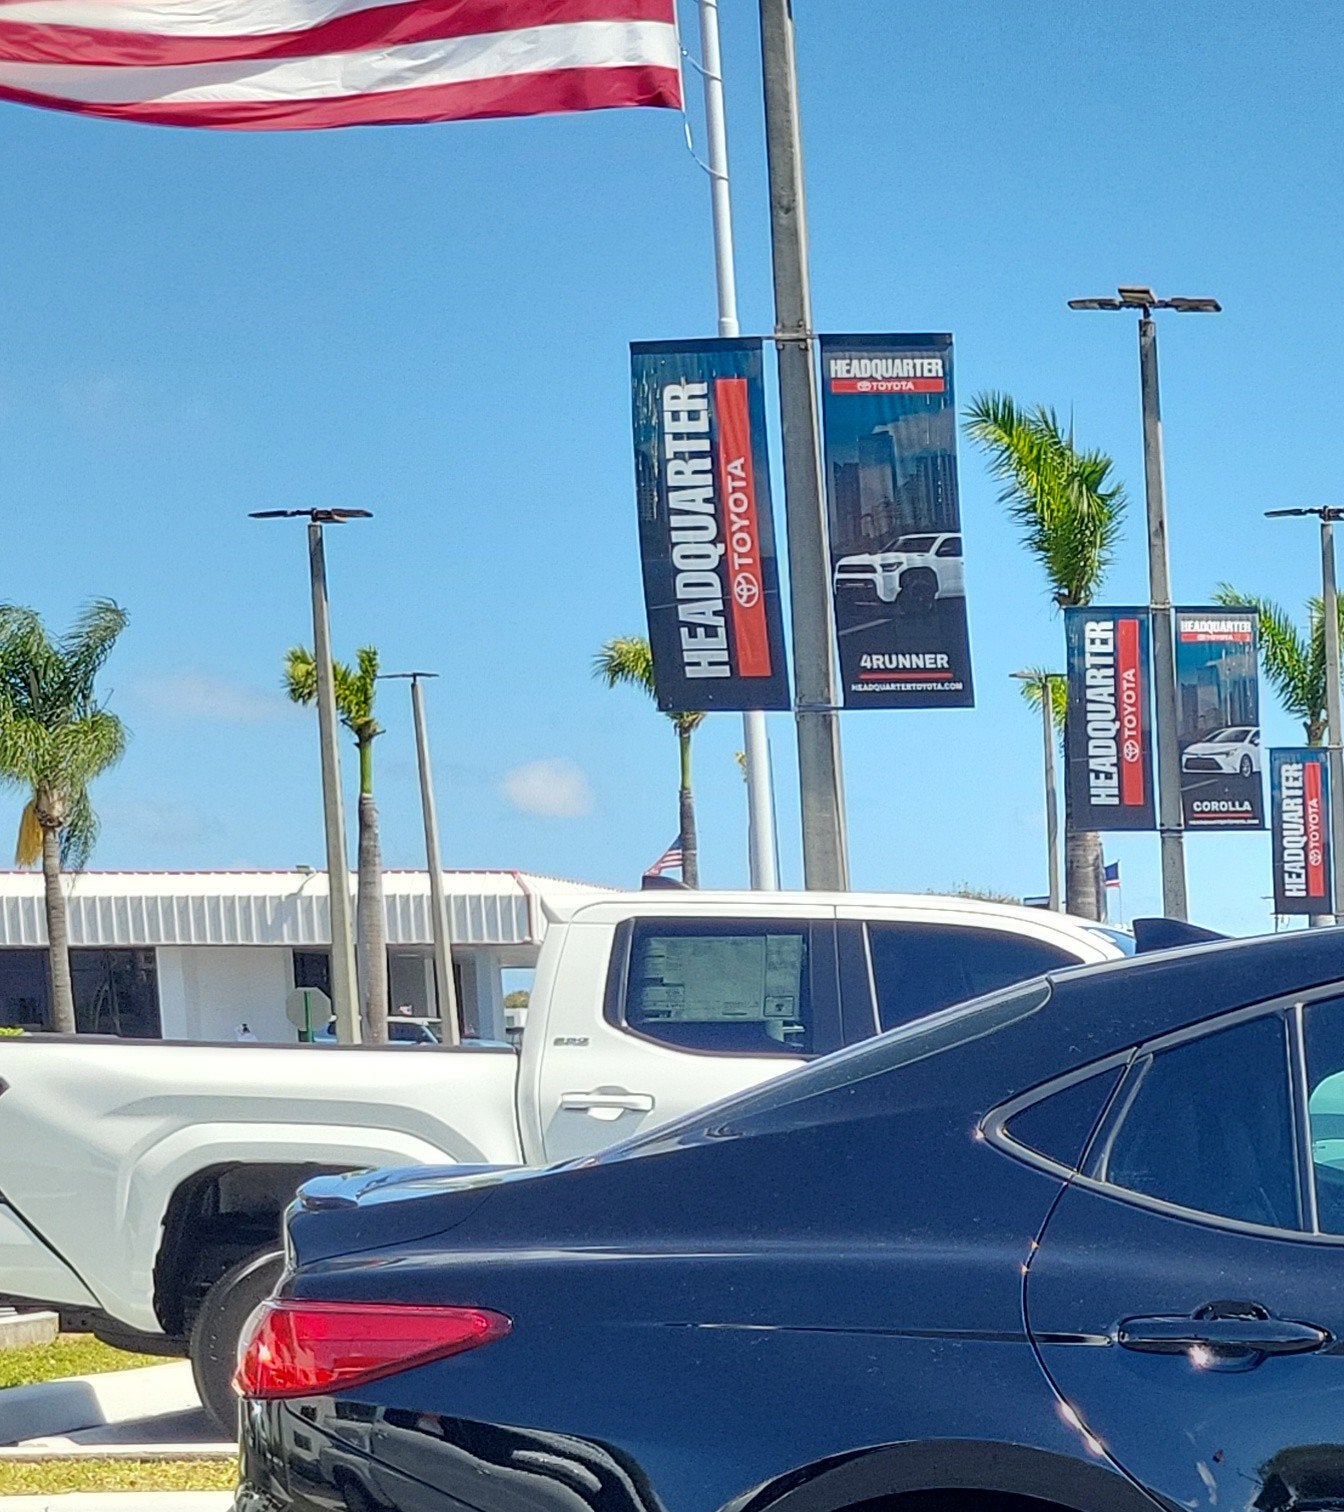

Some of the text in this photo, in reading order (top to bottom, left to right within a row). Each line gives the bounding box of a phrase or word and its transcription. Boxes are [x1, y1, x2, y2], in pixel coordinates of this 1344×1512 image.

[829, 357, 944, 379] HEADQUARTER
[872, 381, 915, 392] TOYOTA
[664, 381, 731, 678] HEADQUARTER
[730, 457, 753, 569] TOYOTA
[1180, 620, 1252, 634] HEADQUARTER
[860, 653, 949, 669] 4RUNNER
[851, 682, 963, 692] HEADQUARTERTOYOTA.COM
[1123, 669, 1137, 738] TOYOTA
[1085, 620, 1120, 806] HEADQUARTER
[1193, 801, 1252, 812] COROLLA
[1310, 798, 1321, 850] TOYOTA
[1282, 763, 1307, 898] HEADQUARTER
